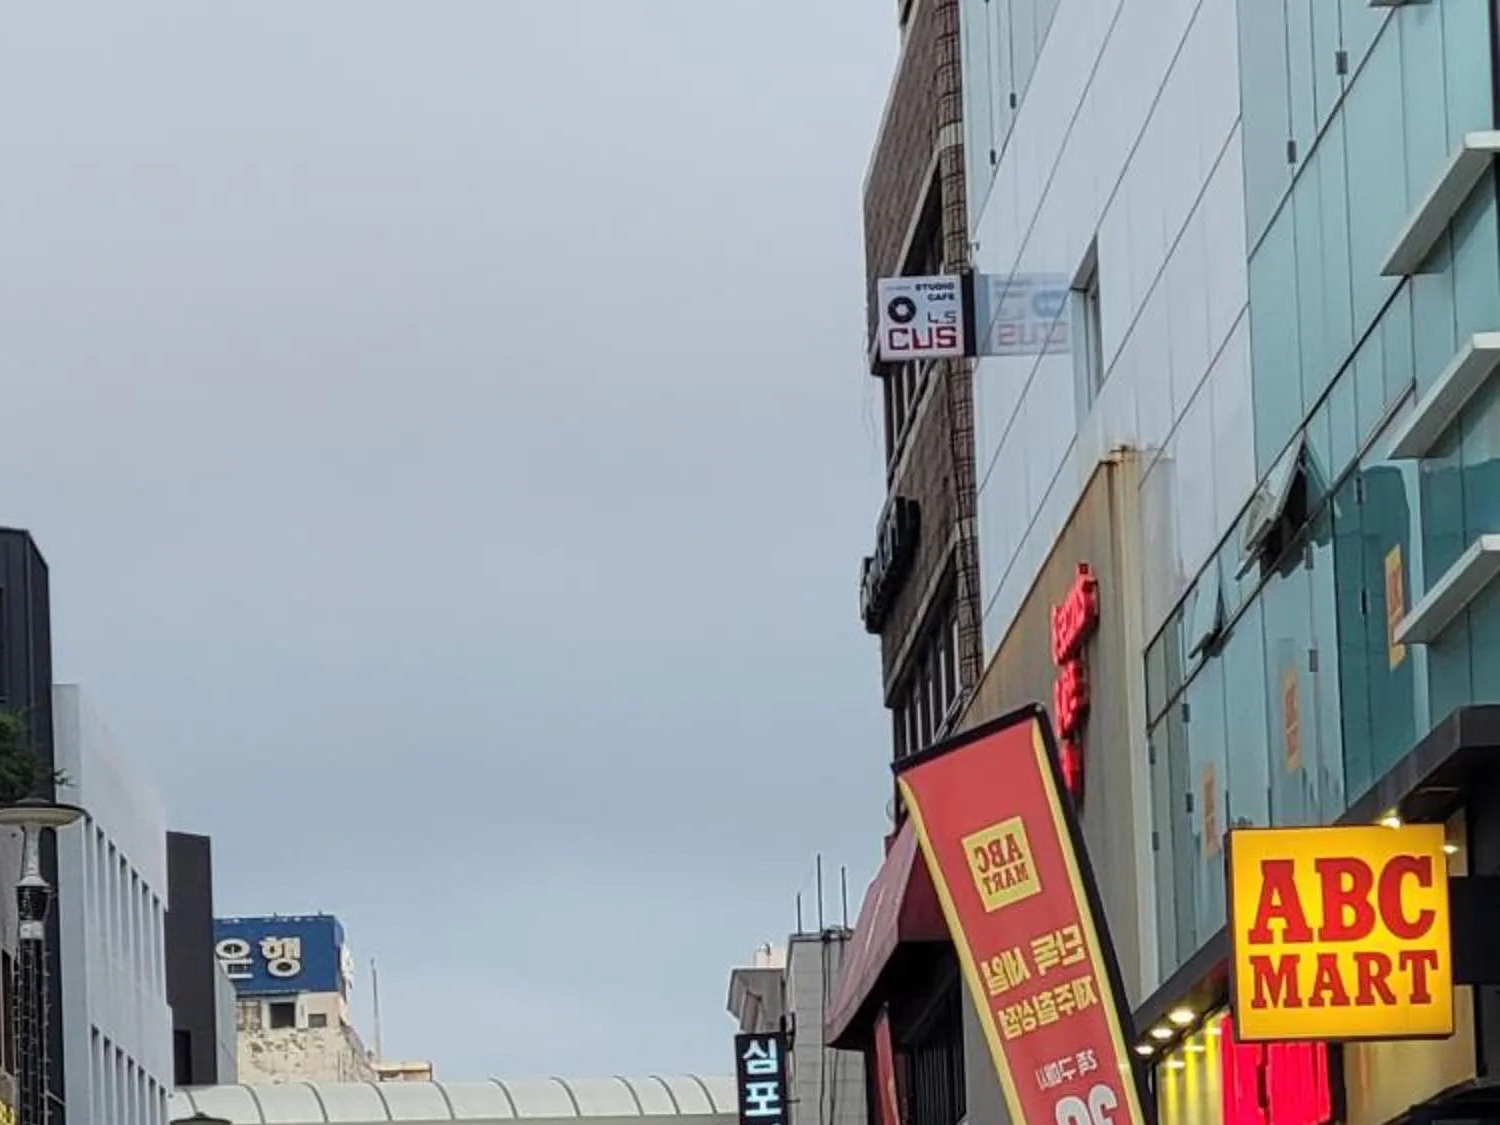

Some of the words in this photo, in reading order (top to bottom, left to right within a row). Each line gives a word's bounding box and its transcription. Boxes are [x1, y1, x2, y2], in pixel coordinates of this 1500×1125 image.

[1248, 854, 1436, 945] ABC
[215, 934, 301, 979] 은행
[1249, 950, 1439, 1009] MART
